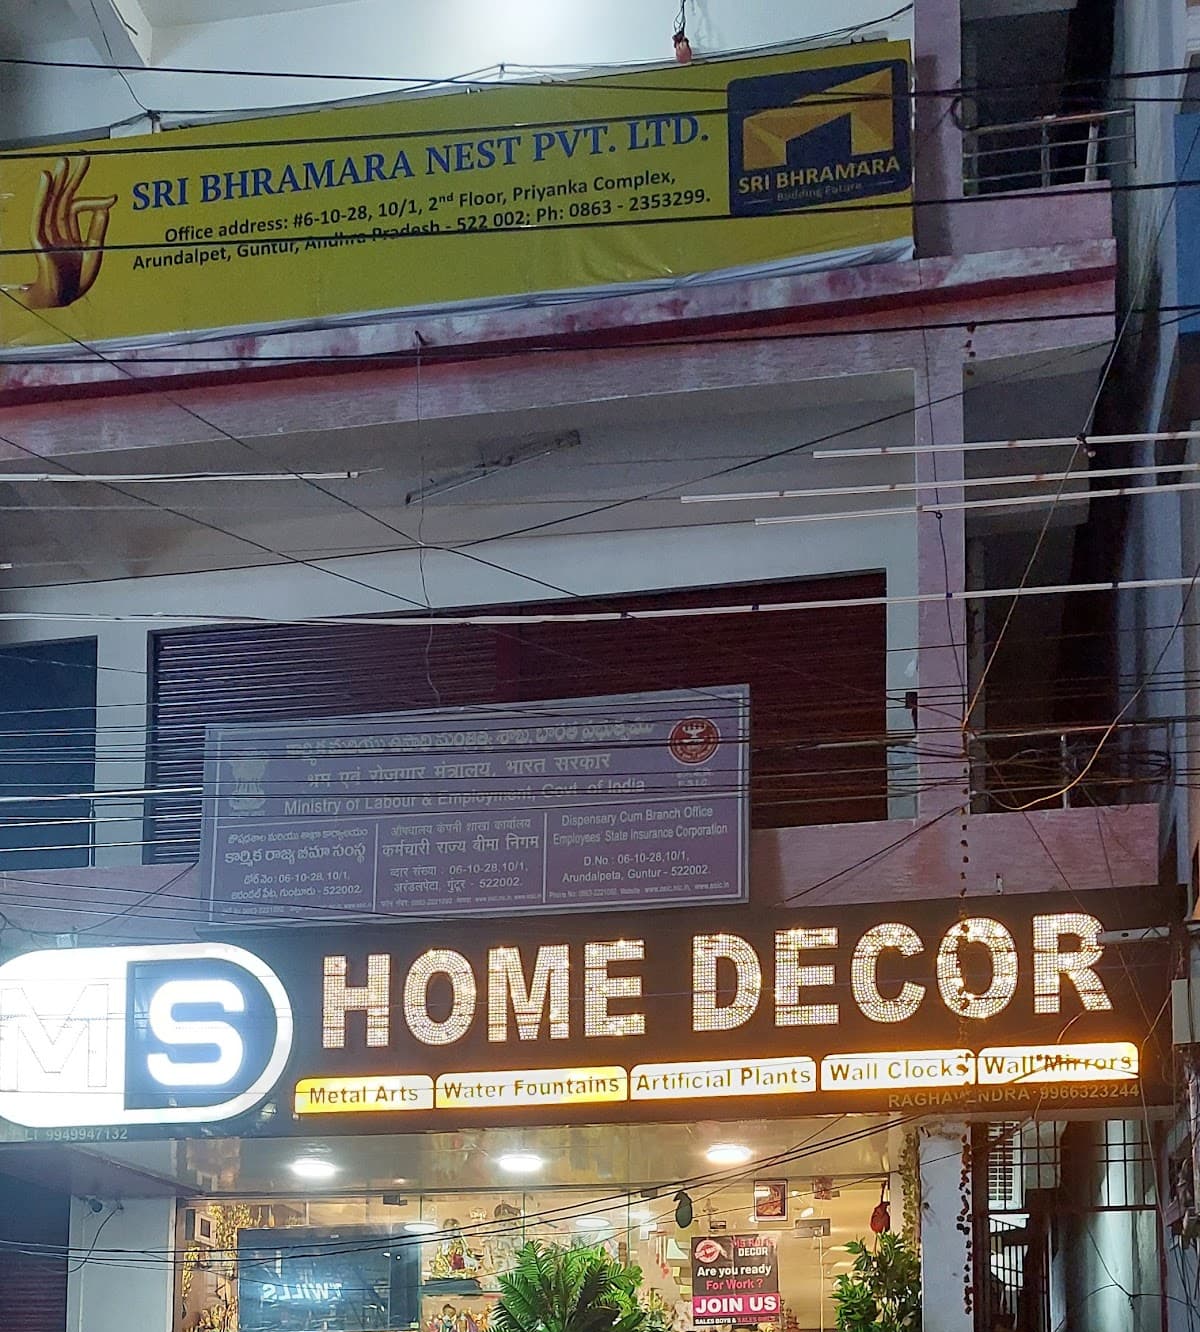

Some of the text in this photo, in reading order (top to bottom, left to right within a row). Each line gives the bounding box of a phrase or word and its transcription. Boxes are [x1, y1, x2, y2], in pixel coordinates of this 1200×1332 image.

[132, 114, 709, 210] SRI BHRAMARA NEST PVT. LTD.
[738, 156, 900, 194] SRI BHRAMARA
[165, 226, 213, 243] Office
[219, 217, 288, 238] address:
[293, 205, 372, 228] #6-10-28,
[378, 198, 423, 215] 10/1,
[459, 190, 507, 208] Floor,
[513, 180, 587, 201] Priyanka
[594, 170, 676, 192] Complex,
[132, 242, 232, 270] Arundalpet,
[237, 238, 299, 258] Guntur,
[457, 210, 488, 231] 522
[493, 209, 530, 228] 002;
[536, 205, 564, 222] Ph:
[569, 200, 612, 217] 0863
[629, 188, 710, 212] 2353299.
[506, 757, 546, 774] भारत
[554, 753, 611, 770] सरकार
[285, 799, 342, 816] Ministry
[346, 797, 360, 812] of
[365, 796, 416, 811] Labour
[608, 777, 645, 793] India
[562, 806, 713, 827] Dispensary Cum Branch Office
[605, 830, 628, 842] State
[630, 827, 673, 840] Insurance
[676, 823, 728, 839] Corporation
[382, 838, 430, 857] कर्मचारी
[436, 840, 467, 854] राज्य
[506, 832, 539, 850] निगम
[627, 867, 661, 879] Guntur
[322, 939, 646, 1049] HOME
[691, 912, 1114, 1032] DECOR
[830, 1060, 968, 1081] Wall Clocks
[984, 1053, 1132, 1074] Wall Mirrors
[444, 1075, 620, 1099] Water Fountains
[636, 1066, 811, 1091] Artificial Plants
[310, 1085, 418, 1104] Metal Arts
[1040, 1083, 1139, 1101] 9966323244
[46, 1127, 128, 1141] 9949947132
[738, 1246, 768, 1257] DECOR
[697, 1263, 772, 1278] Are you ready
[706, 1279, 764, 1291] For Work ?
[695, 1296, 777, 1314] JOIN US
